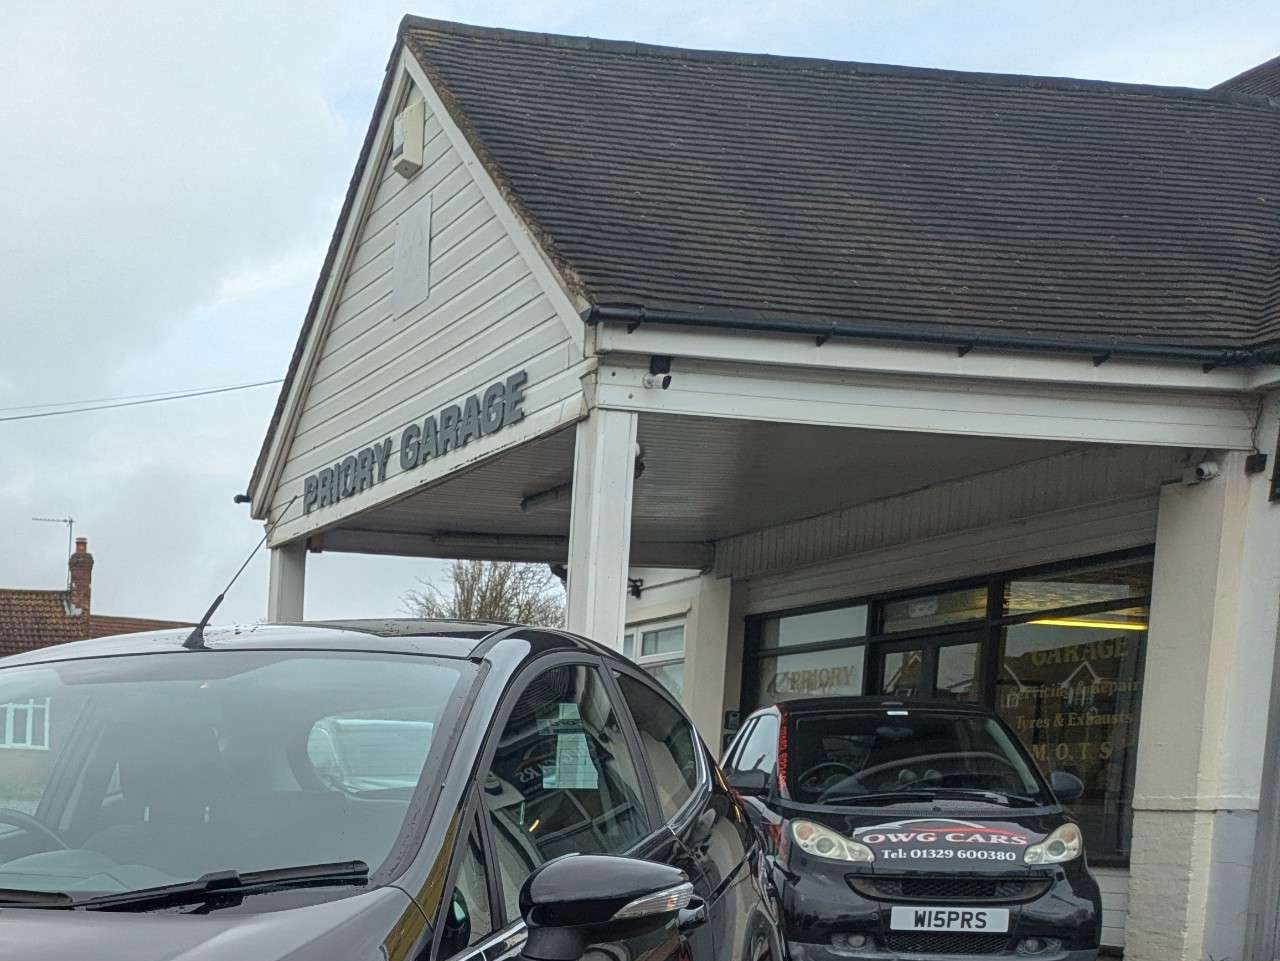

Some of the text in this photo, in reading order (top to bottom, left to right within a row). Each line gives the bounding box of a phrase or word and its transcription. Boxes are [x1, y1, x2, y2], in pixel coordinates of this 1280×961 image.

[303, 369, 528, 515] PRIORY GARAGE
[1032, 637, 1129, 666] GARAGE
[1017, 714, 1051, 733] Tyres
[1053, 713, 1064, 728] &
[863, 832, 1028, 845] OWG CARS
[881, 849, 1017, 861] Tel: 01329 600380
